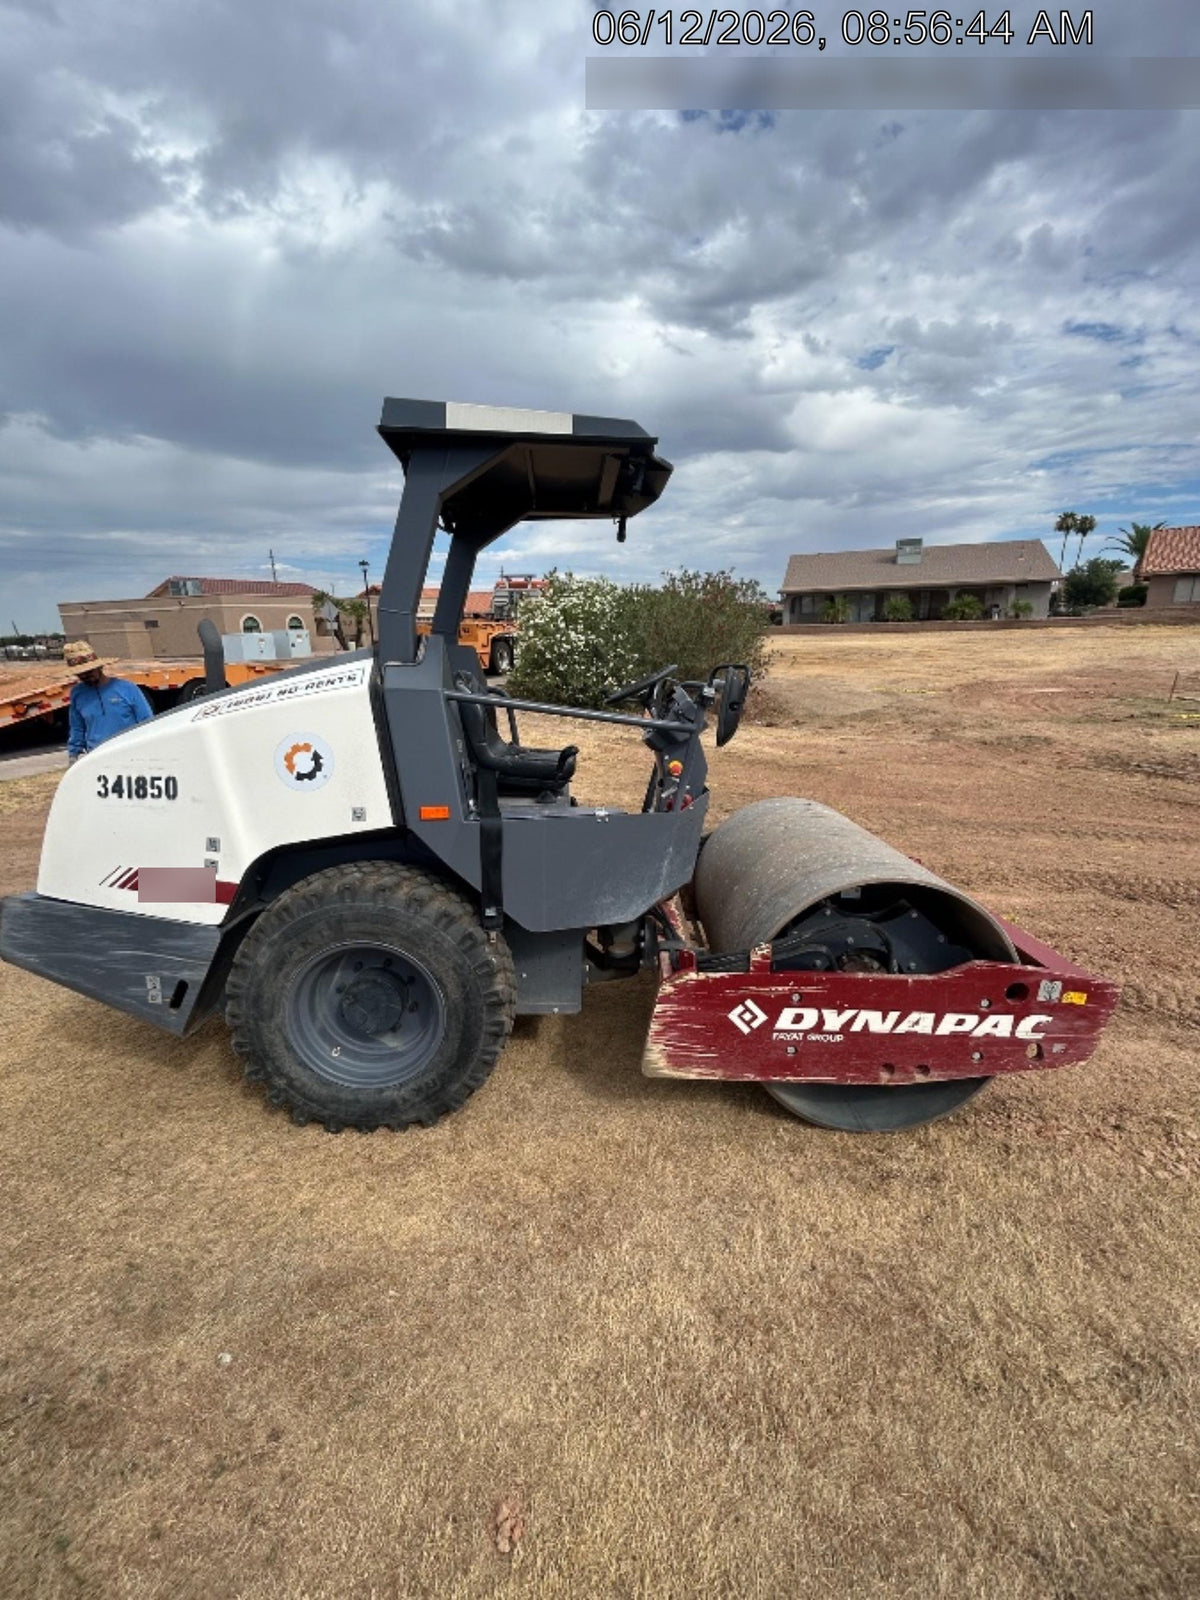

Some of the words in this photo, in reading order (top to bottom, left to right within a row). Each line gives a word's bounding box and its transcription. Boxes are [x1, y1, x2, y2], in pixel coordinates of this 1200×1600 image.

[96, 774, 178, 800] 341850
[773, 1007, 1053, 1039] DYNAPAC
[772, 1032, 804, 1041] FAYAT
[806, 1033, 844, 1042] GROUP
